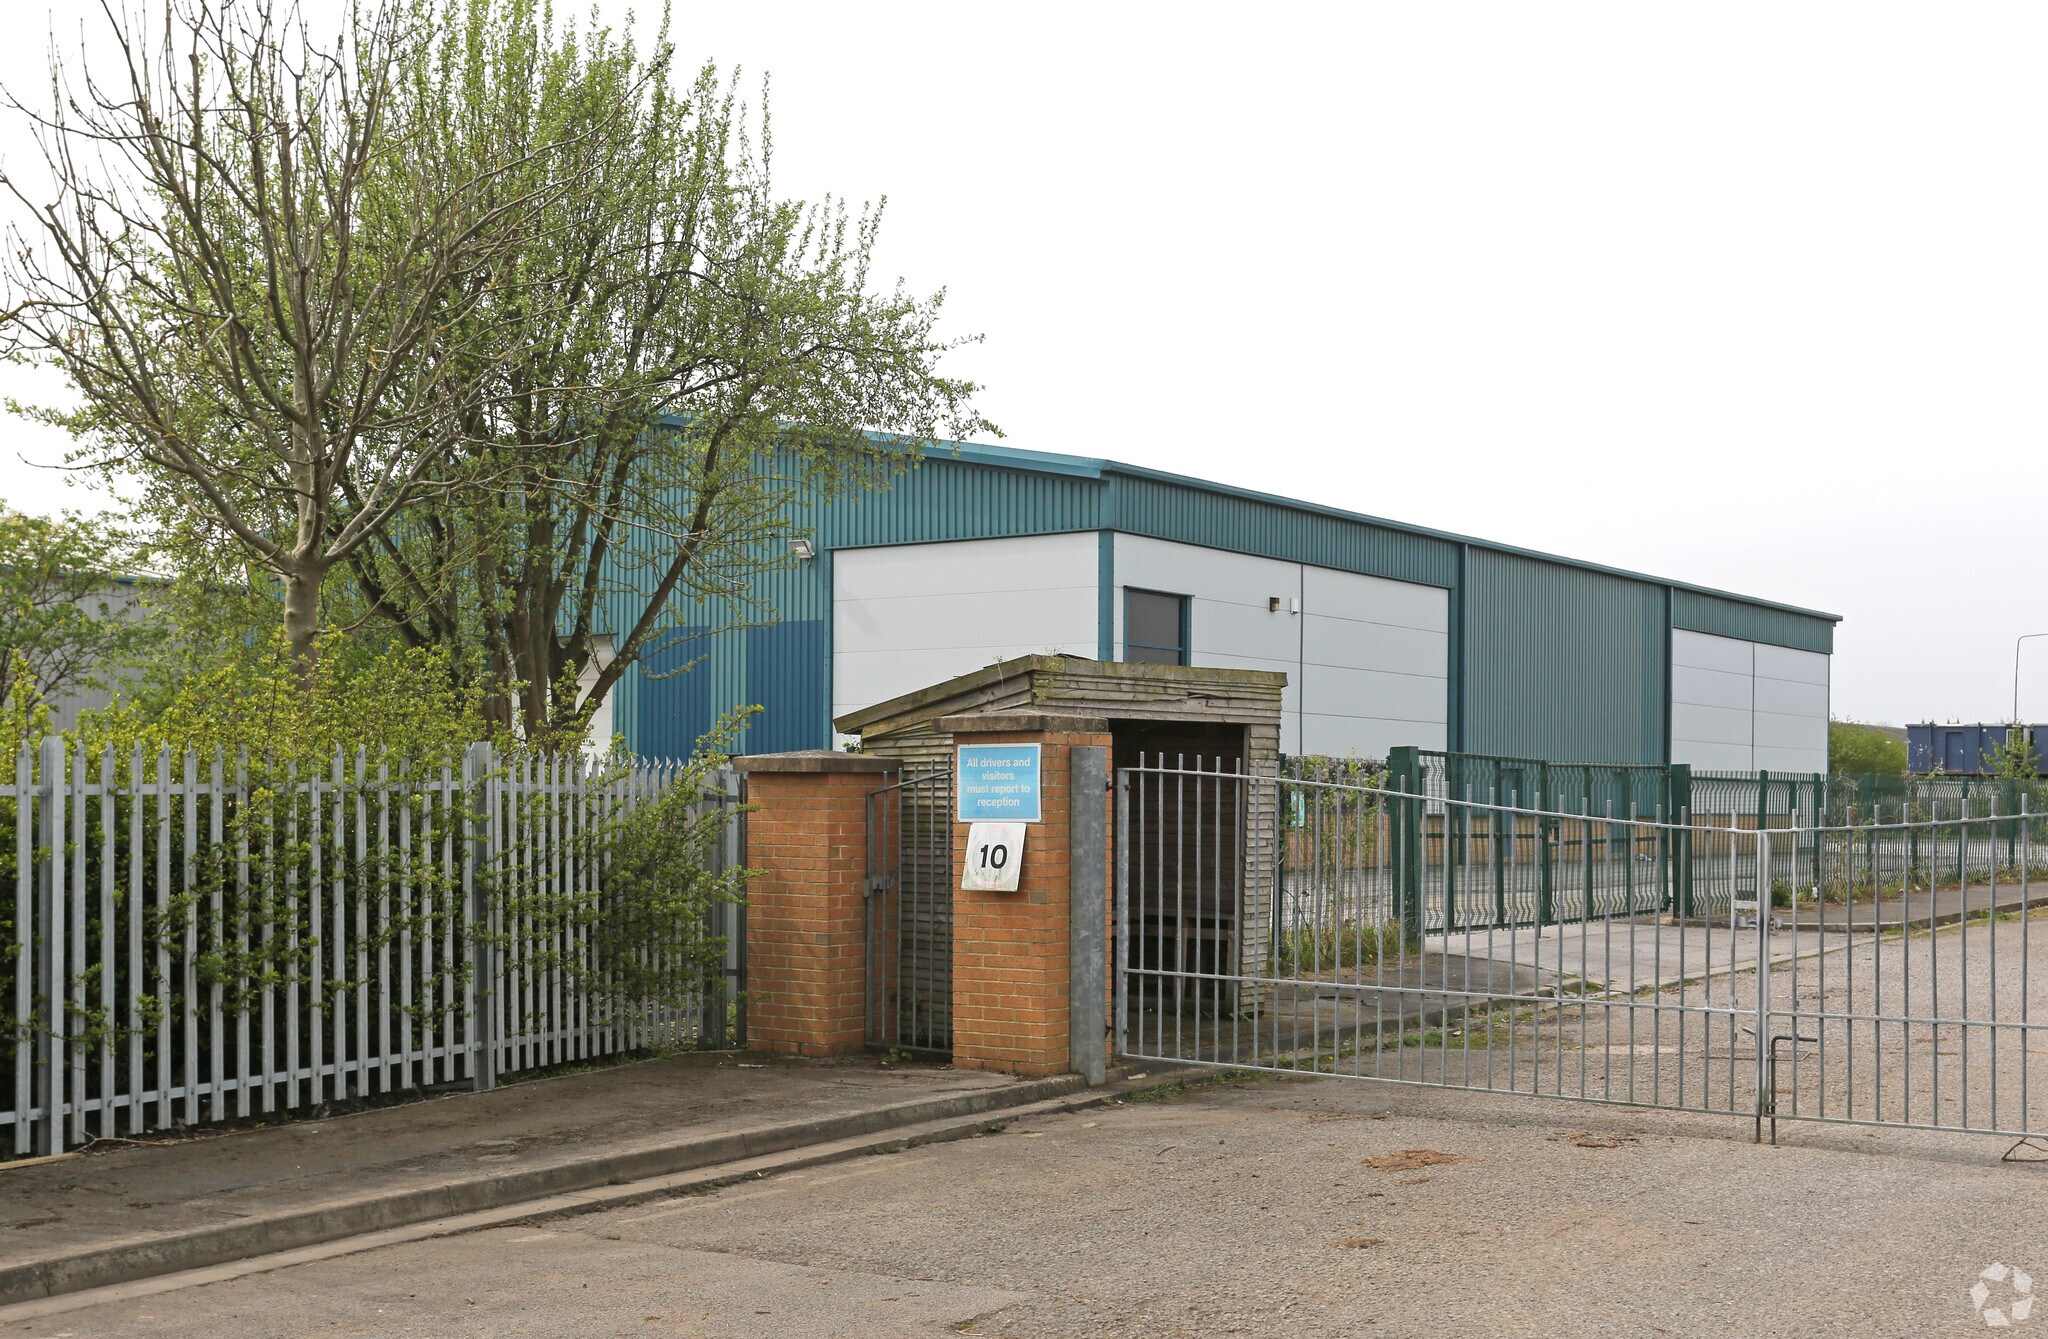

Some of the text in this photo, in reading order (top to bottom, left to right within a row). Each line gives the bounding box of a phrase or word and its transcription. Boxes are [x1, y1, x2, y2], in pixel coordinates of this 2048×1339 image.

[967, 757, 1030, 767] All drivers and
[982, 771, 1015, 780] visitors
[967, 784, 1031, 795] must report to
[977, 797, 1020, 808] reception
[980, 844, 1008, 869] 10
